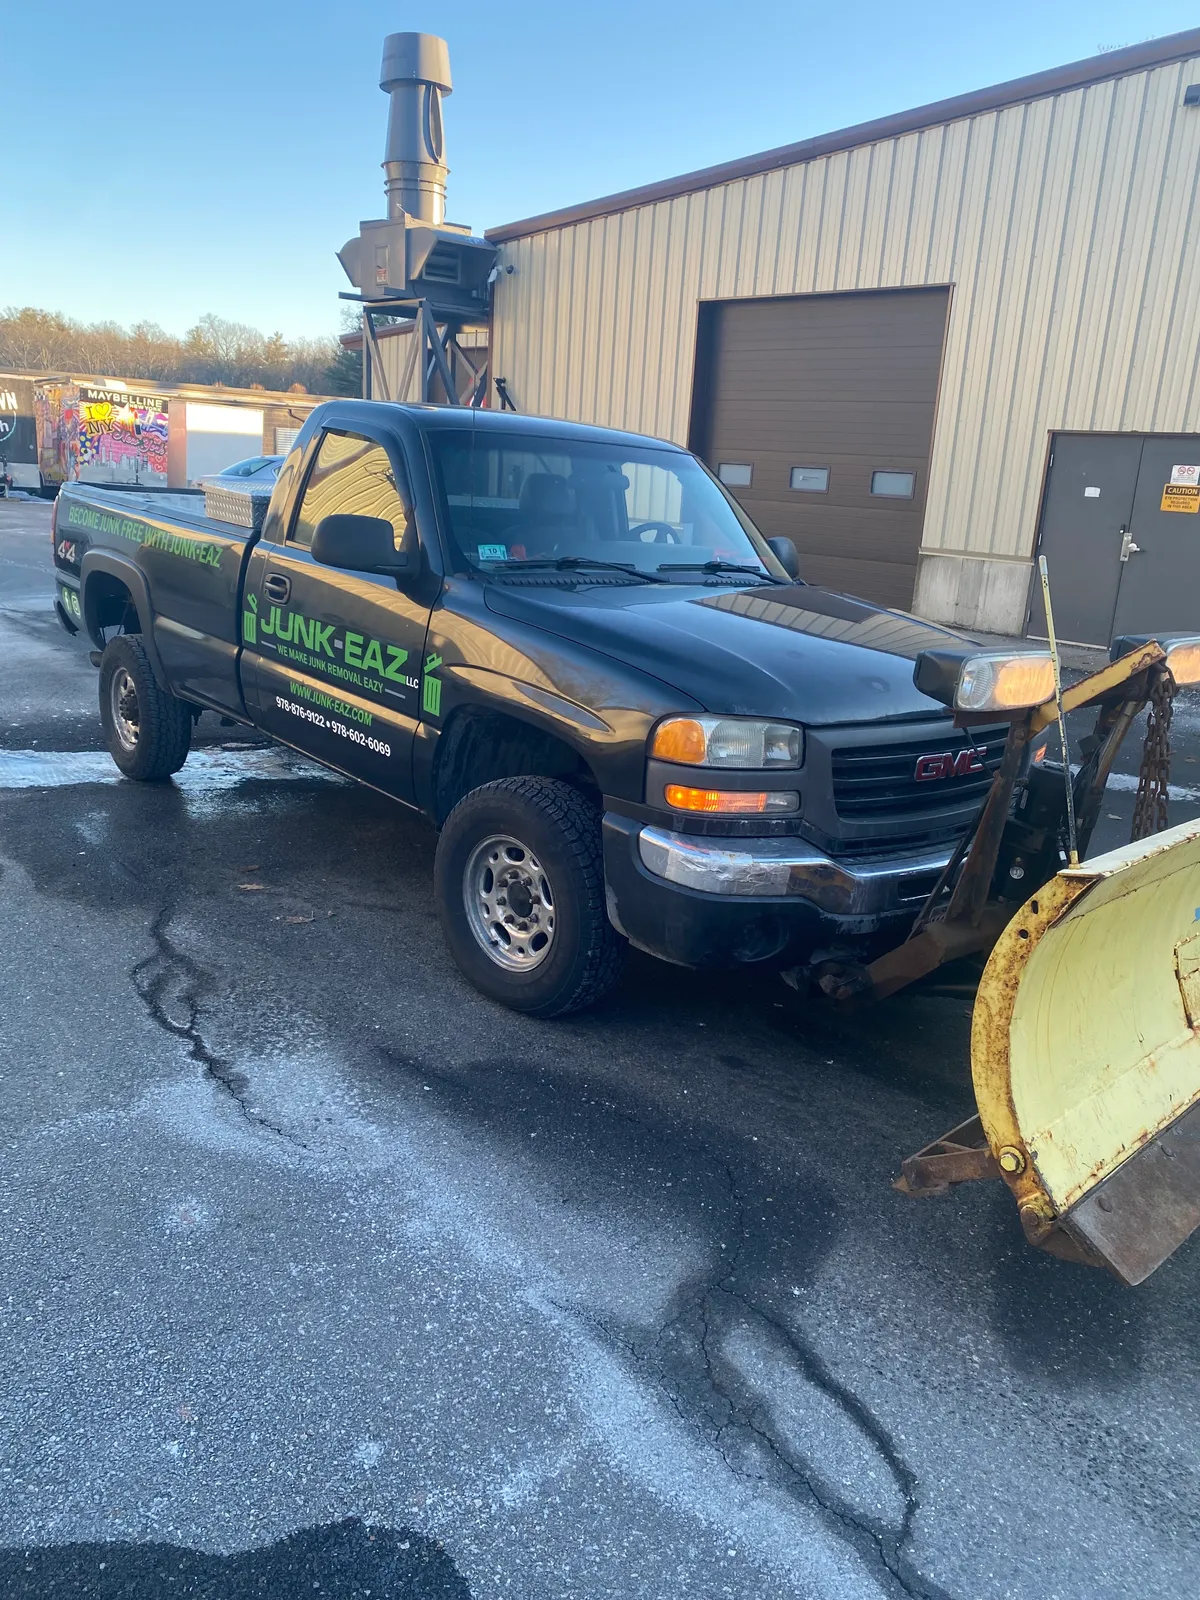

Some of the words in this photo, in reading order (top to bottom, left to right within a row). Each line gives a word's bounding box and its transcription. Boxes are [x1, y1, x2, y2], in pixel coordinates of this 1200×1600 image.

[87, 389, 163, 408] MAYBELLINE
[144, 405, 162, 413] YORK
[86, 417, 114, 435] NY
[112, 430, 139, 446] New
[1168, 487, 1198, 495] CAUTION
[69, 506, 99, 530] BECOME
[98, 512, 121, 536] JUNK
[120, 520, 144, 542] FREE
[144, 527, 169, 550] WITH
[260, 606, 409, 684] JUNK-EAZ
[406, 675, 419, 689] LLC
[277, 643, 289, 656] WE
[288, 647, 309, 663] MAKE
[308, 657, 327, 672] JUNK
[327, 663, 363, 687] REMOVAL
[363, 676, 384, 694] EAZY
[289, 681, 373, 727] WWW.JUNK-EAZ.COM
[275, 696, 325, 728] 978-876-9122
[331, 722, 391, 757] 978-602-6069
[914, 746, 987, 782] GMC
